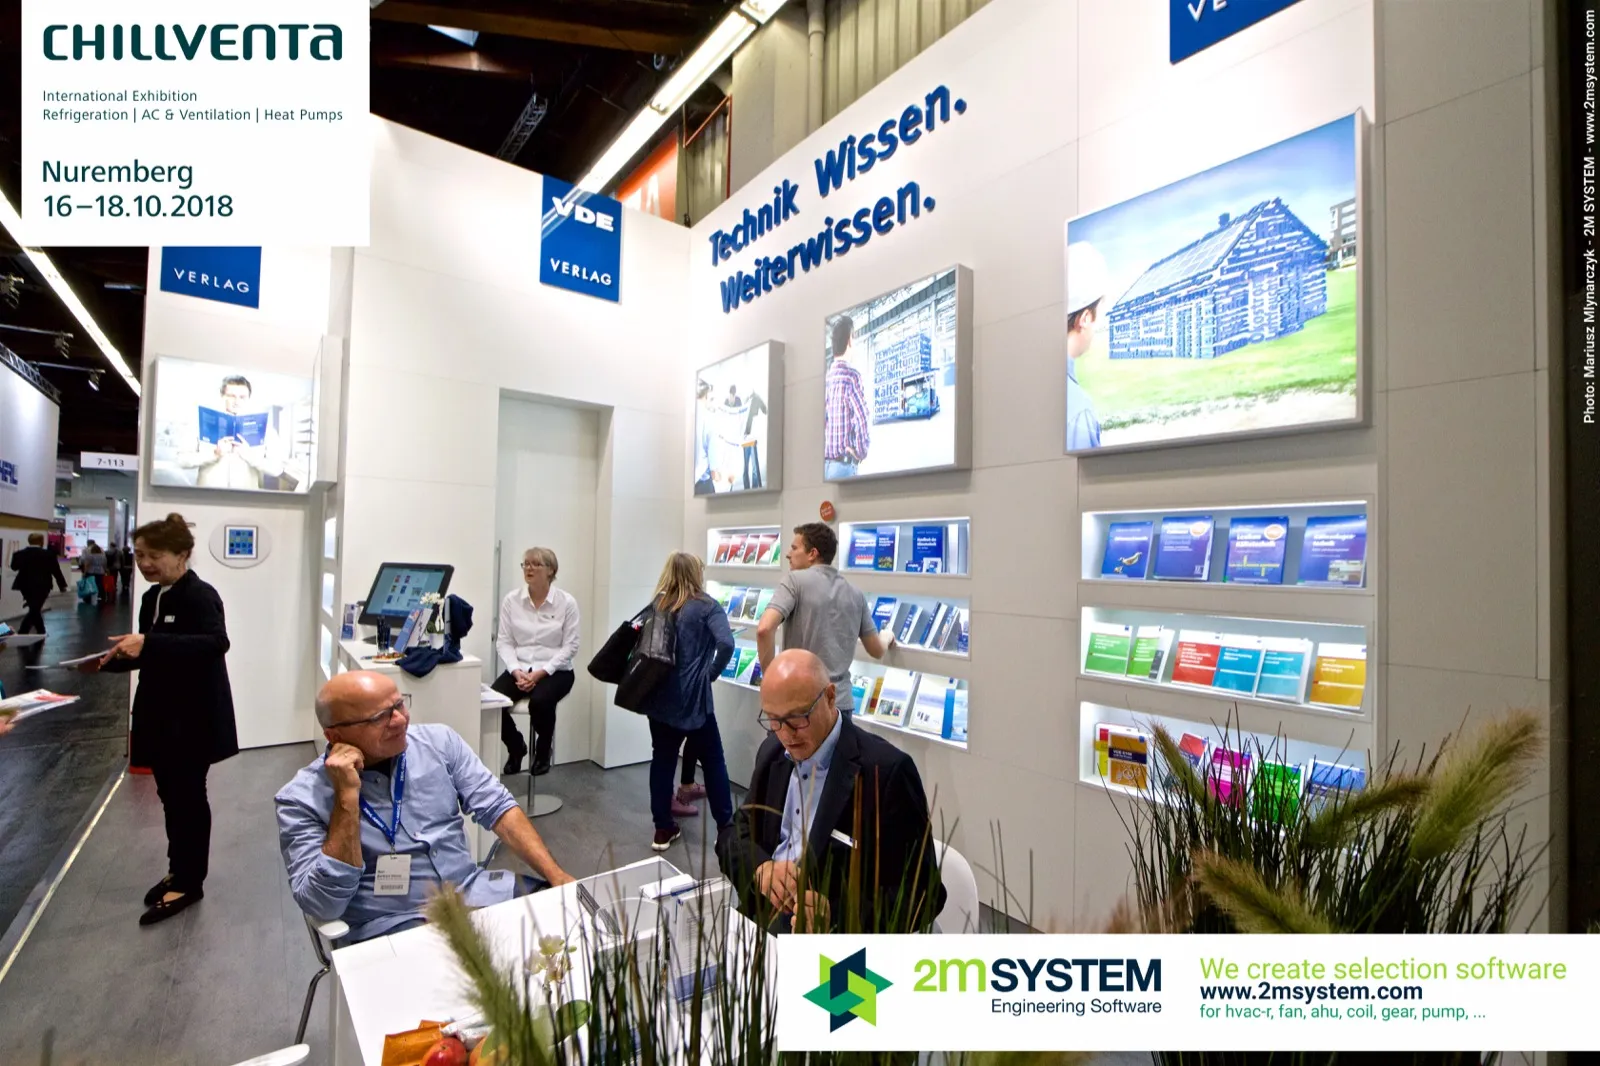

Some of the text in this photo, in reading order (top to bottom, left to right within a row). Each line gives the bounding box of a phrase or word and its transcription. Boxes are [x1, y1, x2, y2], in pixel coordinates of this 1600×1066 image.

[708, 84, 968, 267] Technik Wissen.
[552, 196, 614, 232] VDE
[720, 181, 936, 314] Weiterwissen.
[173, 267, 250, 293] VERLAG
[550, 257, 612, 286] VERLAG
[97, 458, 125, 467] 7-113
